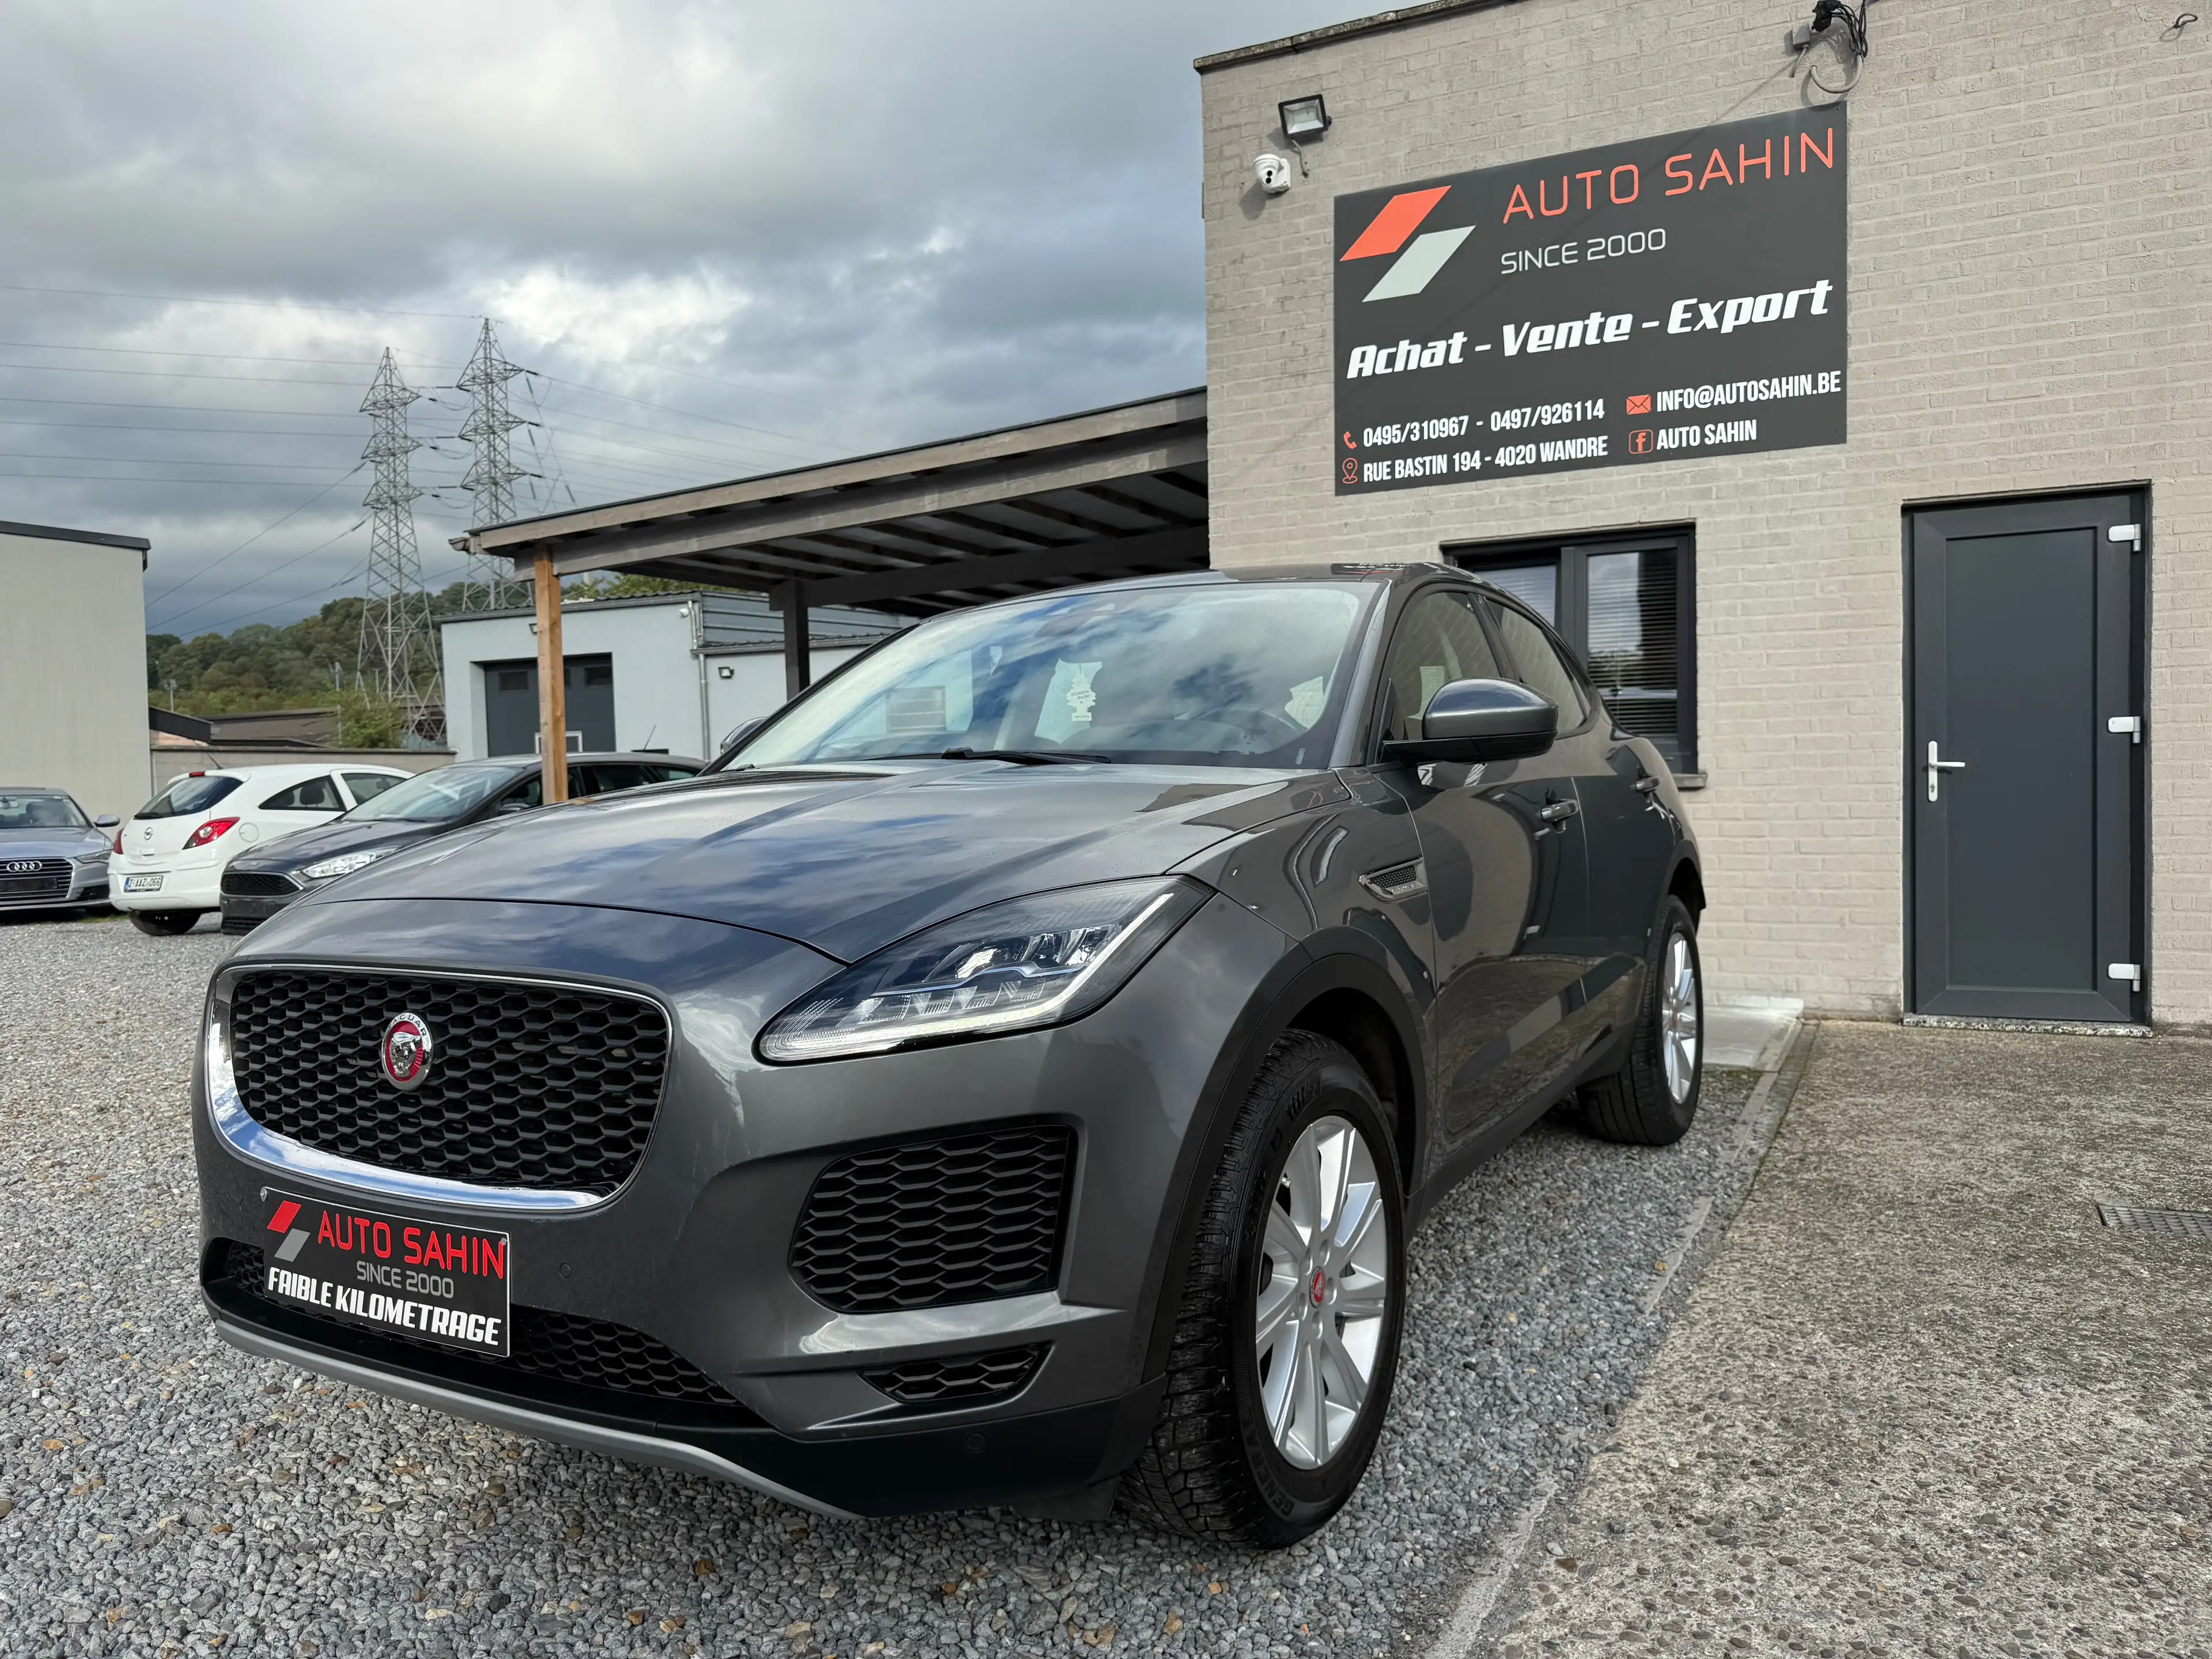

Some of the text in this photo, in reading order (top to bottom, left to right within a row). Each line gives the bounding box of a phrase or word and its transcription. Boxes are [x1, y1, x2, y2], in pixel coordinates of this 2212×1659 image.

[1503, 128, 1834, 224] AUTO SAHIN
[1500, 228, 1666, 275] SINCE 2000
[1346, 331, 1468, 379] Achat
[1502, 311, 1633, 357] Vente
[1667, 279, 1833, 334] Export
[1657, 370, 1842, 412] INFO@AUTOSAHIN.BE
[1363, 415, 1469, 448] 0495/310967
[1490, 398, 1605, 431] 0497/926114
[1656, 423, 1700, 450] AUTO
[1704, 419, 1757, 445] SAHIN
[1363, 460, 1392, 483] RUE
[1395, 454, 1448, 479] BASTIN
[1452, 450, 1482, 472] 194
[1494, 444, 1536, 467] 4020
[1539, 435, 1608, 463] WANDRE
[317, 1210, 505, 1280] AUTO SAHIN
[356, 1260, 454, 1298] SINCE 2000
[268, 1267, 502, 1346] FAIBLE KILOMETRAGE
